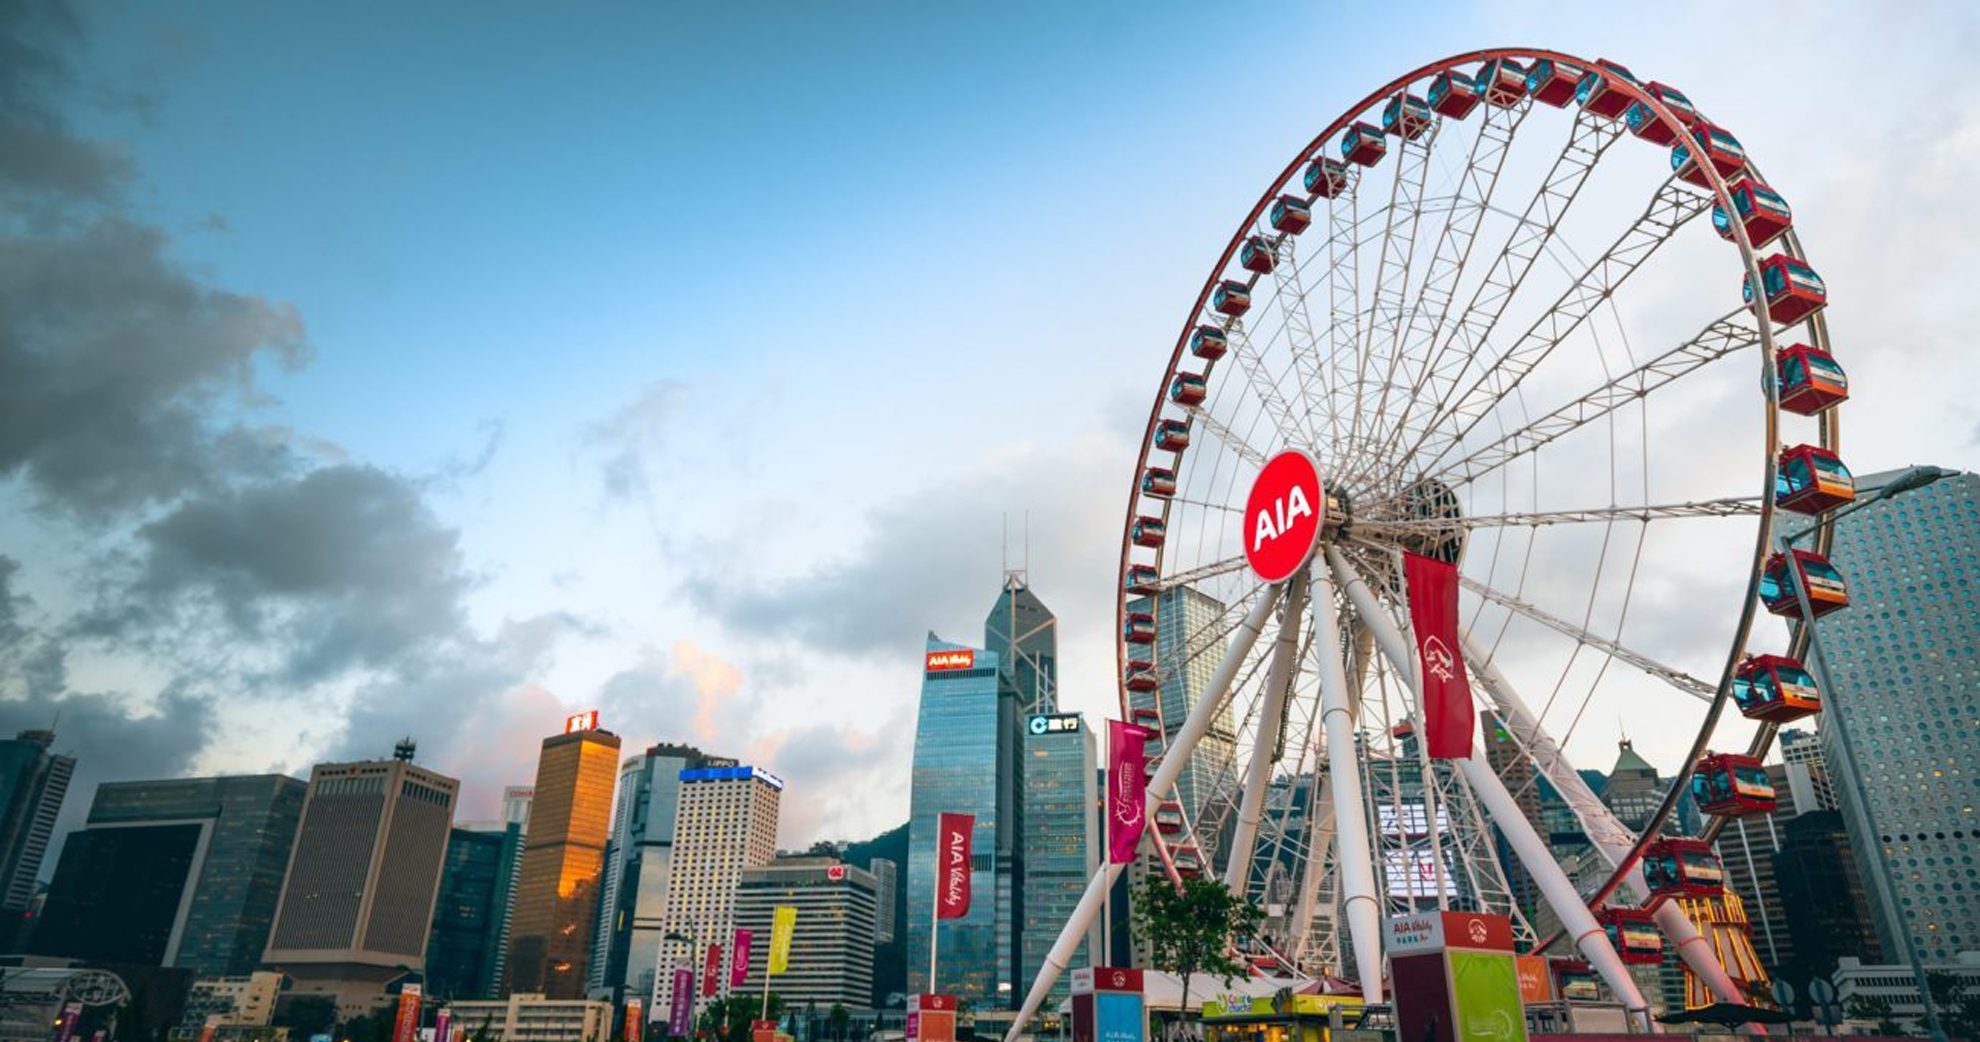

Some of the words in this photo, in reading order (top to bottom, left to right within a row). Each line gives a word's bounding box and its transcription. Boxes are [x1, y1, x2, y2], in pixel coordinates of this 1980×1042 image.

[1254, 484, 1312, 553] AIA
[928, 655, 949, 666] AIA
[707, 758, 735, 768] LIPPO
[951, 832, 964, 865] AIA
[945, 866, 965, 906] Vitality
[1393, 922, 1411, 934] AIA
